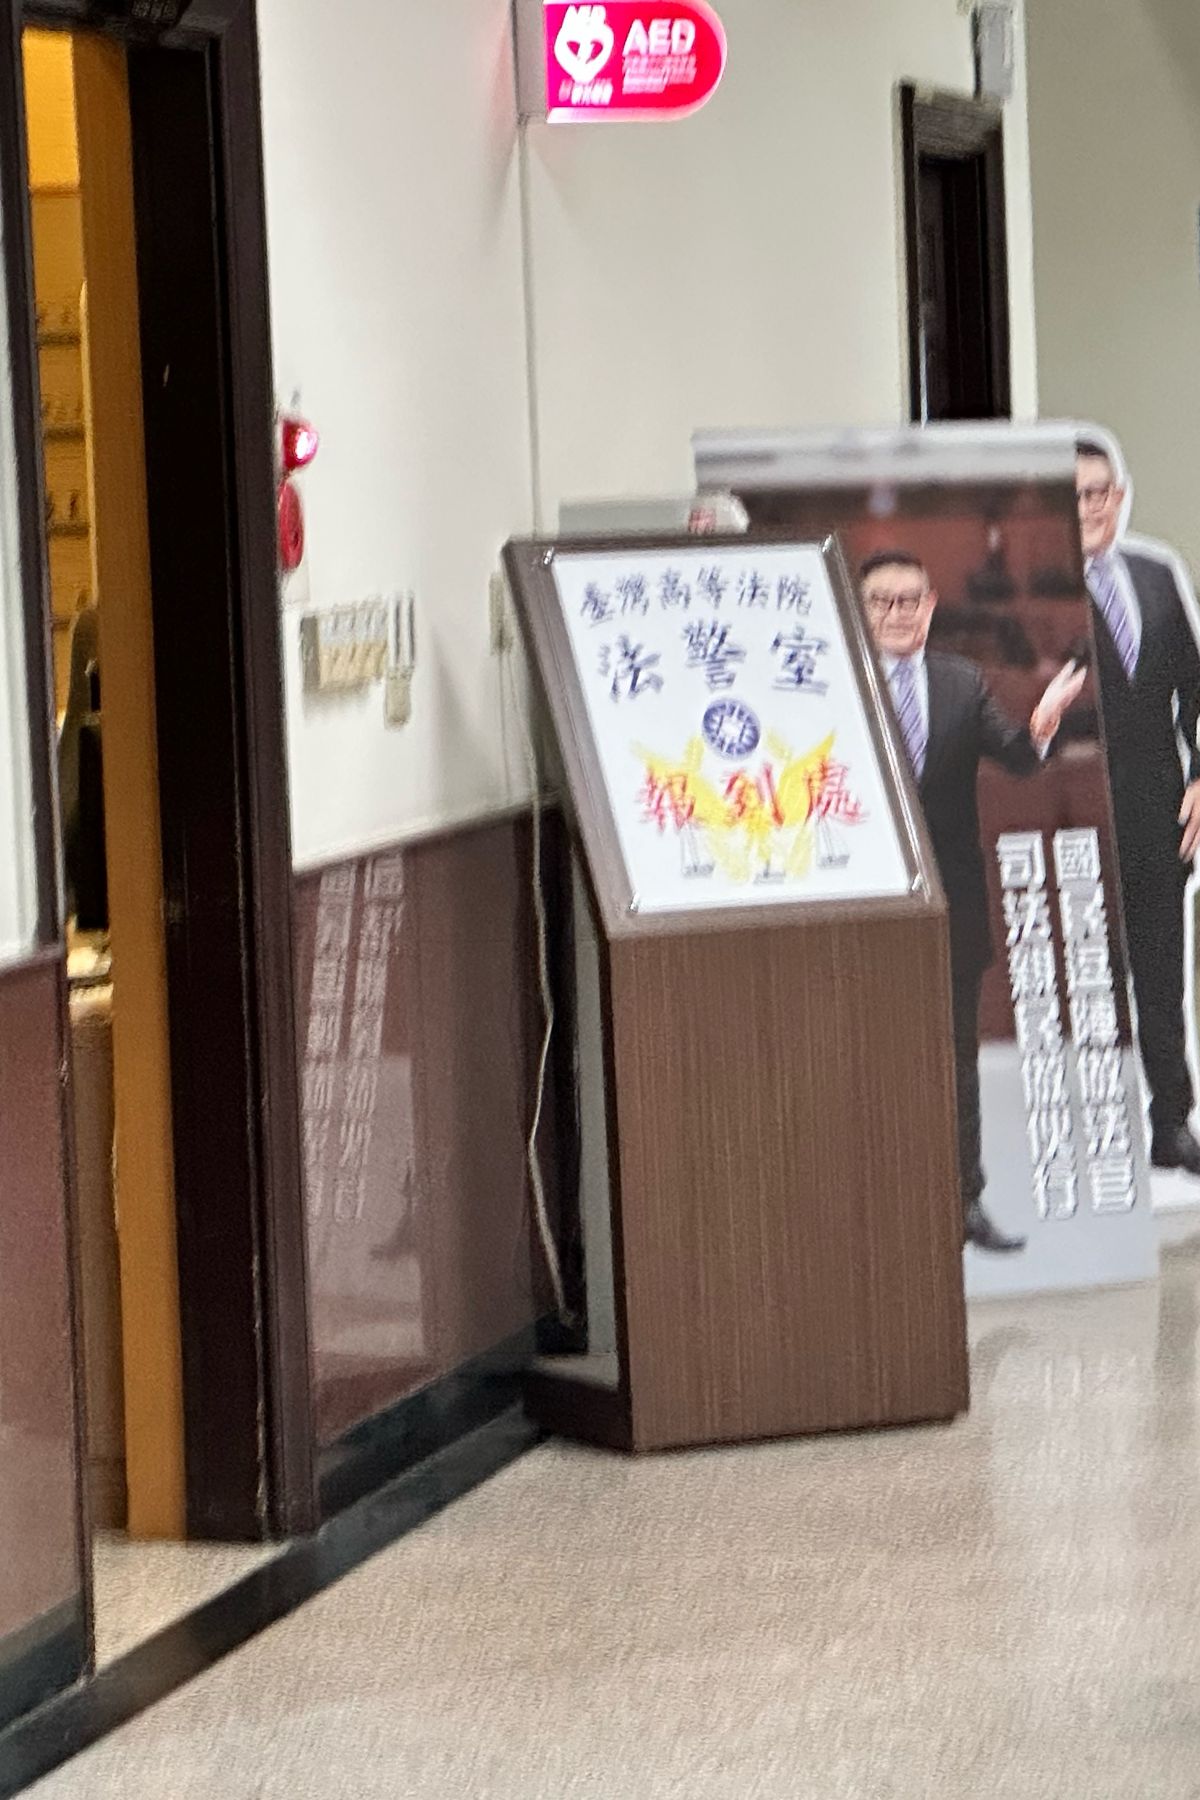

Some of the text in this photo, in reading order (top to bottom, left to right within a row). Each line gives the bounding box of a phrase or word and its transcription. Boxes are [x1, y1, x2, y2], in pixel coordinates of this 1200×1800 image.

[622, 18, 696, 56] AED
[598, 621, 830, 702] 法警室
